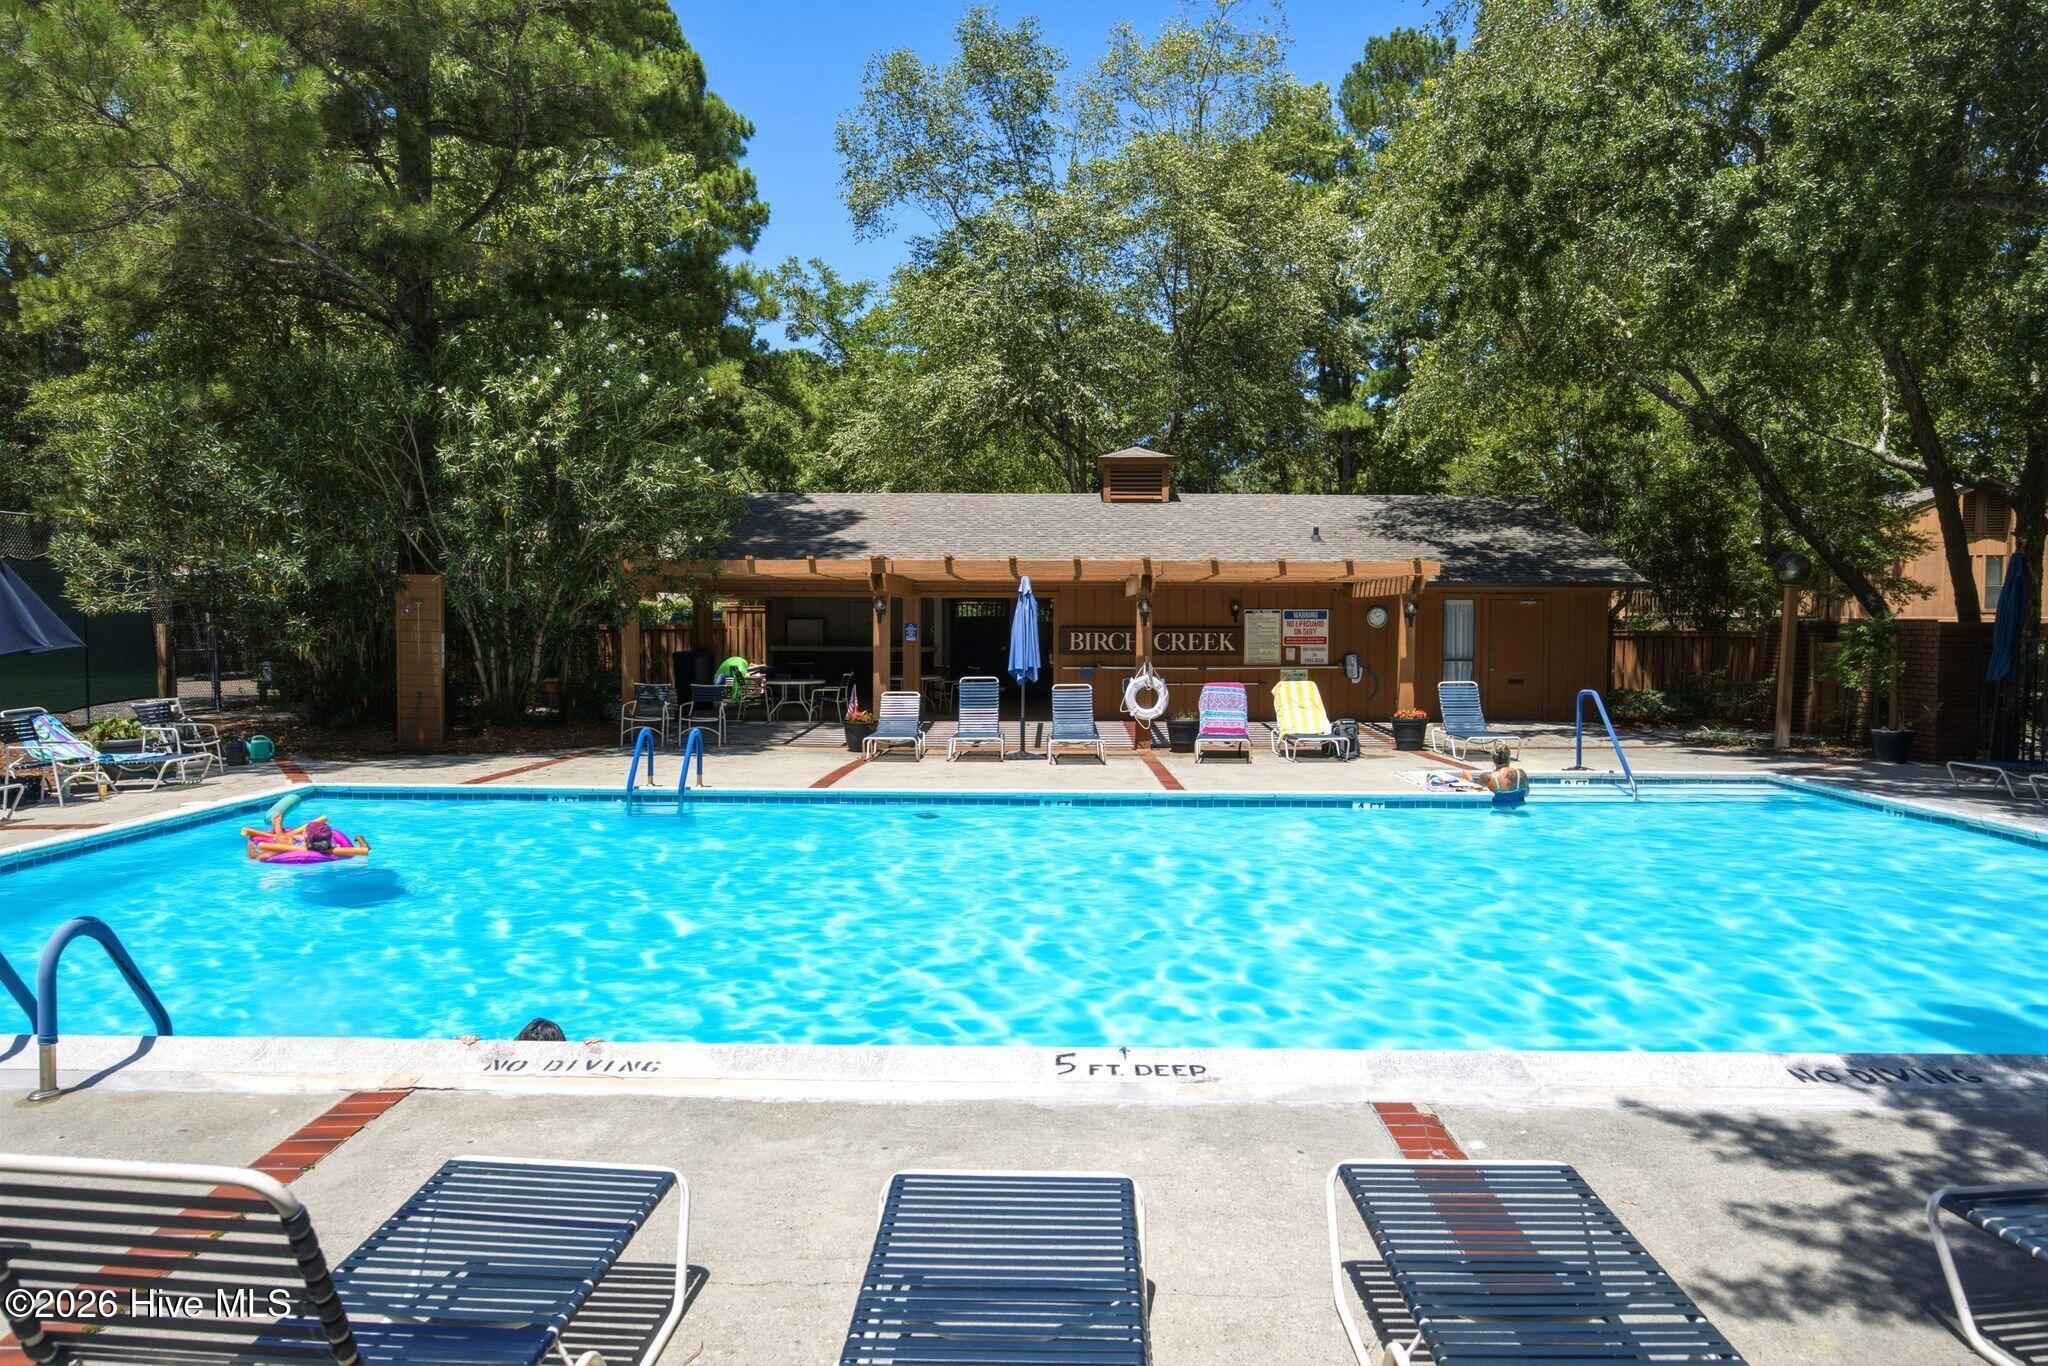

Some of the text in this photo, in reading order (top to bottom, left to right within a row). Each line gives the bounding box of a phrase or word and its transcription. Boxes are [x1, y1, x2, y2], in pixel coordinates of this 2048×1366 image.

[1286, 620, 1325, 628] NO LIFEGUARD
[1153, 632, 1236, 651] CREEK
[483, 1059, 662, 1073] NO DIVING
[1055, 1052, 1076, 1075] 5
[1134, 1064, 1207, 1077] DEEP
[1786, 1068, 1984, 1084] NO DIVING
